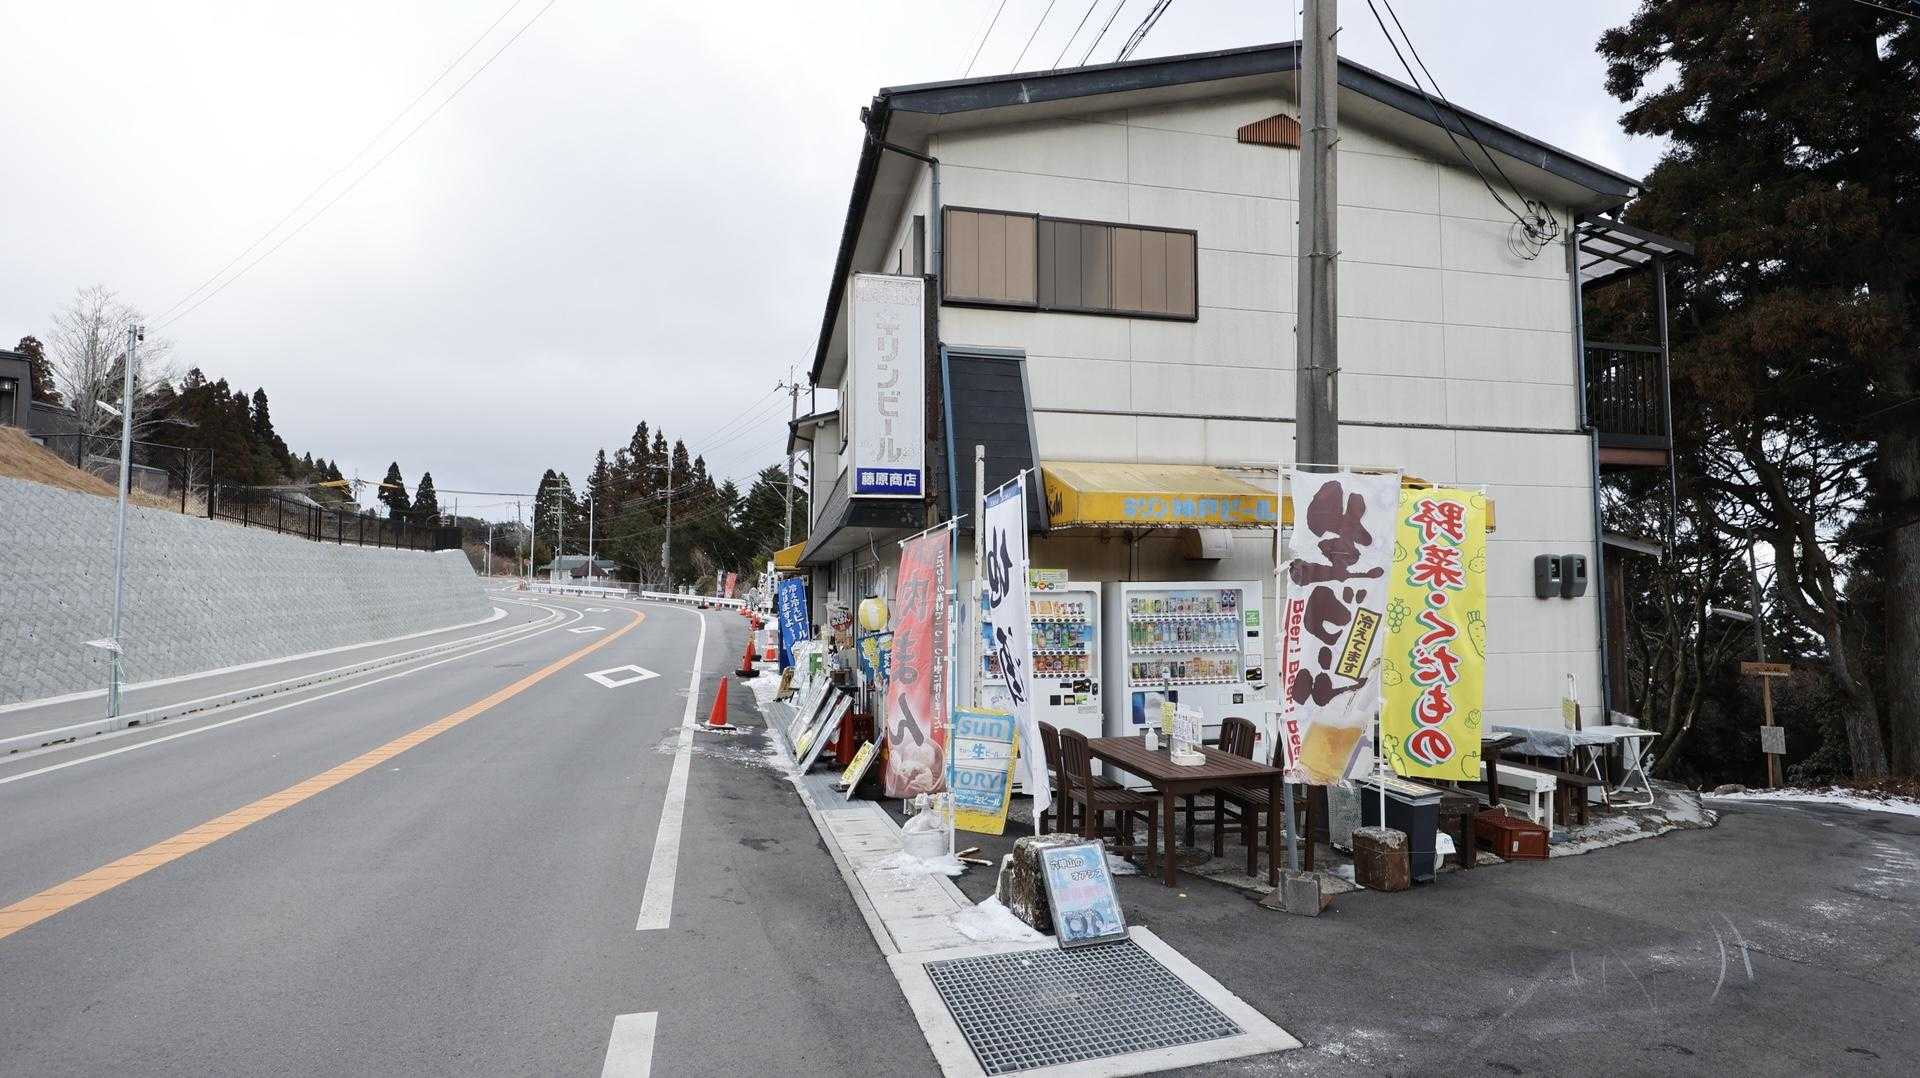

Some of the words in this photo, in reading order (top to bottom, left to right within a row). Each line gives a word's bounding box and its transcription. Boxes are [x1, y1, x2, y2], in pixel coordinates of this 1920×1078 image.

[861, 471, 917, 487] 藤原商店
[1289, 480, 1384, 707] 生ビール
